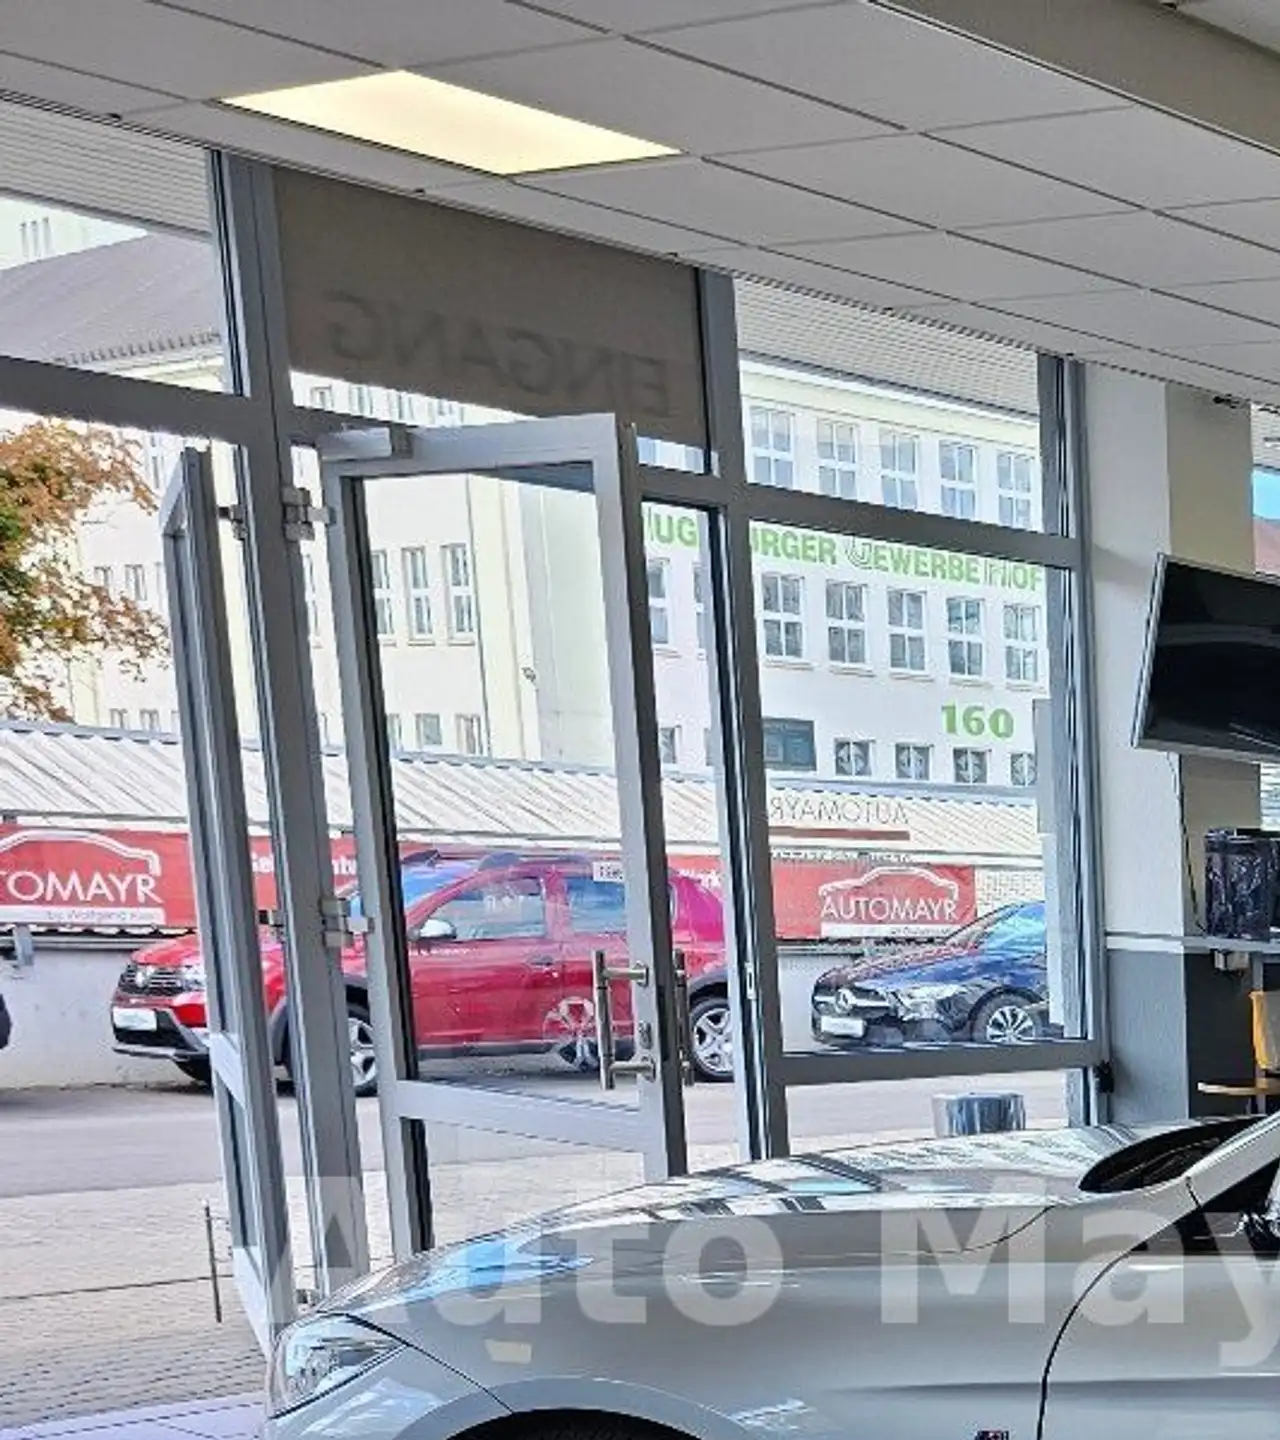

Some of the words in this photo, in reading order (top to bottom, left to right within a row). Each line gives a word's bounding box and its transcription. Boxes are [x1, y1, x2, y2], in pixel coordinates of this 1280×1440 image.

[941, 704, 1014, 739] 160
[0, 870, 164, 904] OMAYR
[820, 896, 959, 922] AUTOMAYR
